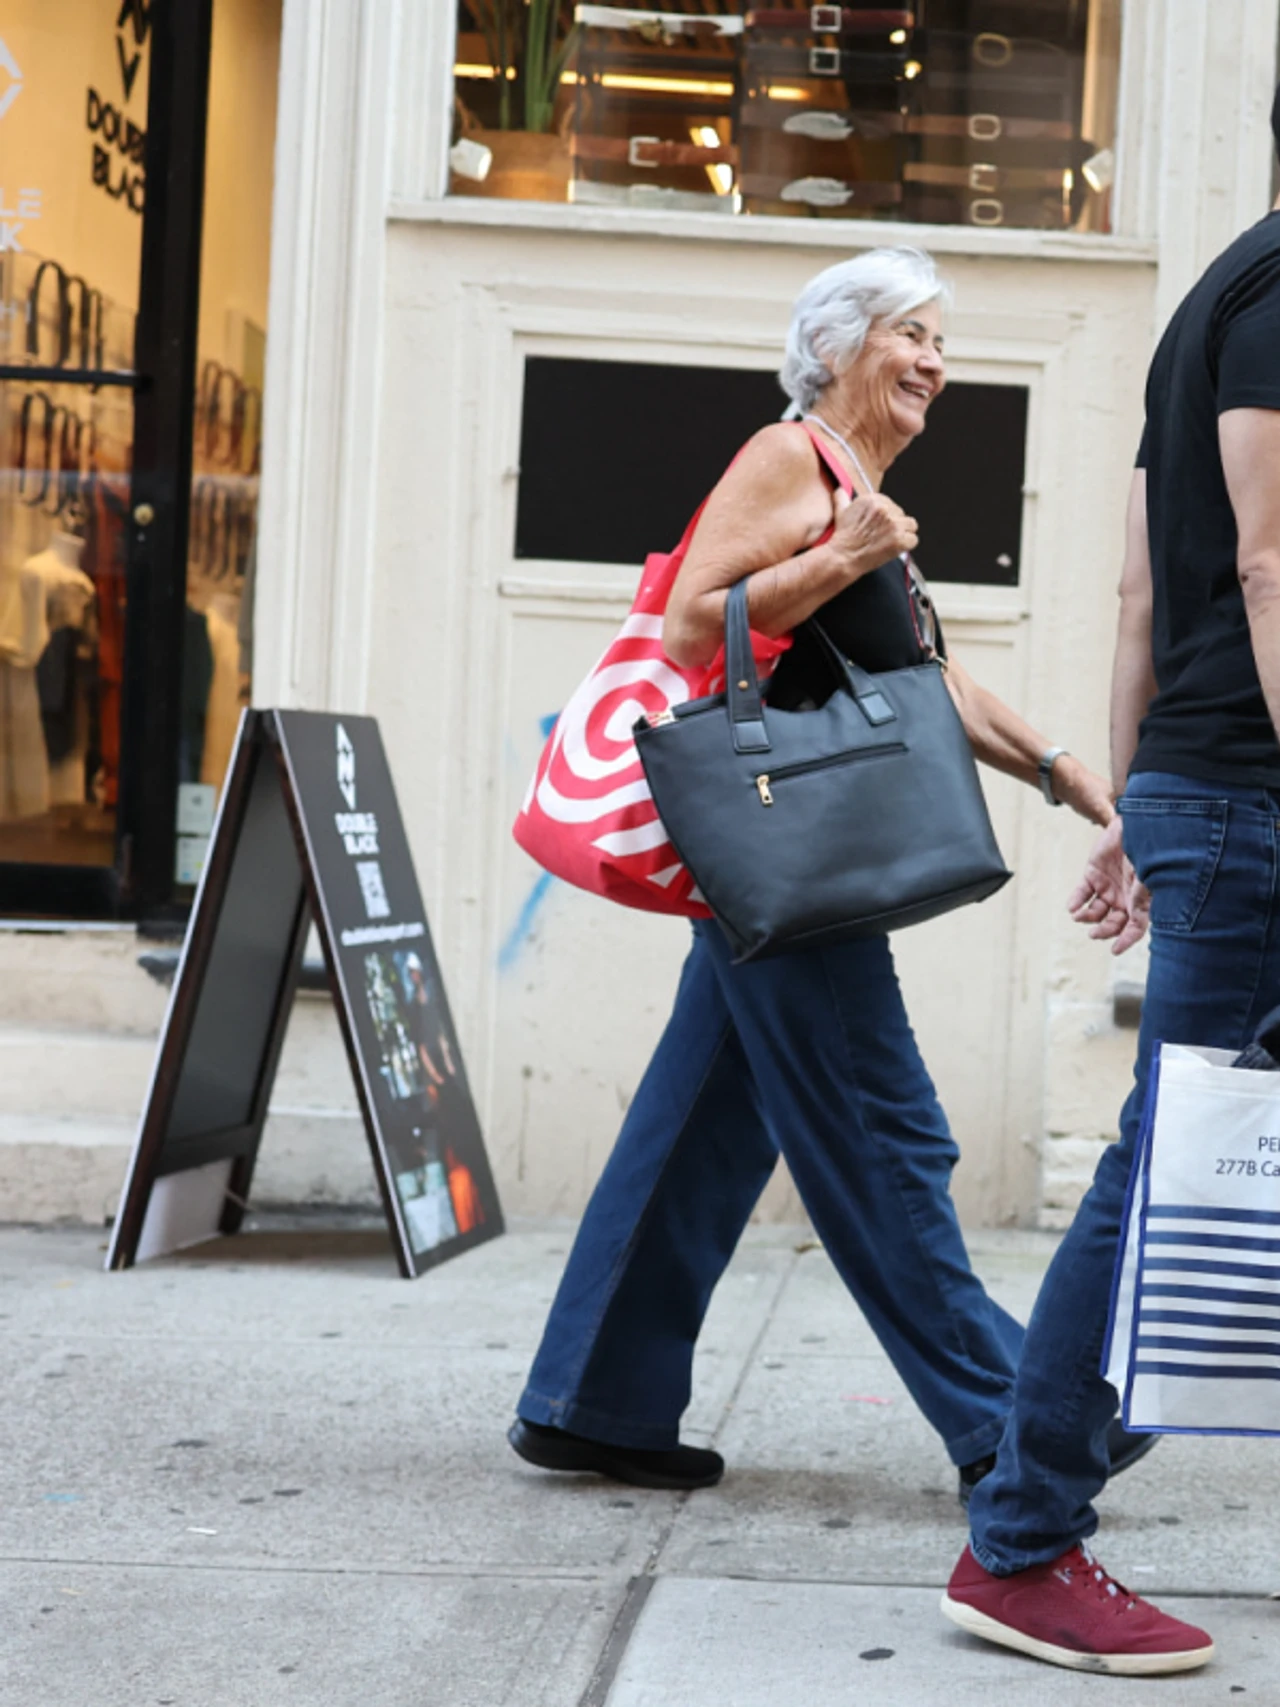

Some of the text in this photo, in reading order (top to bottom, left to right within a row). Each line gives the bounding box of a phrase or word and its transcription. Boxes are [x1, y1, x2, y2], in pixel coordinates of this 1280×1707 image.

[86, 85, 149, 165] DOUB
[92, 142, 146, 215] BLAC
[1215, 1158, 1257, 1177] 277B
